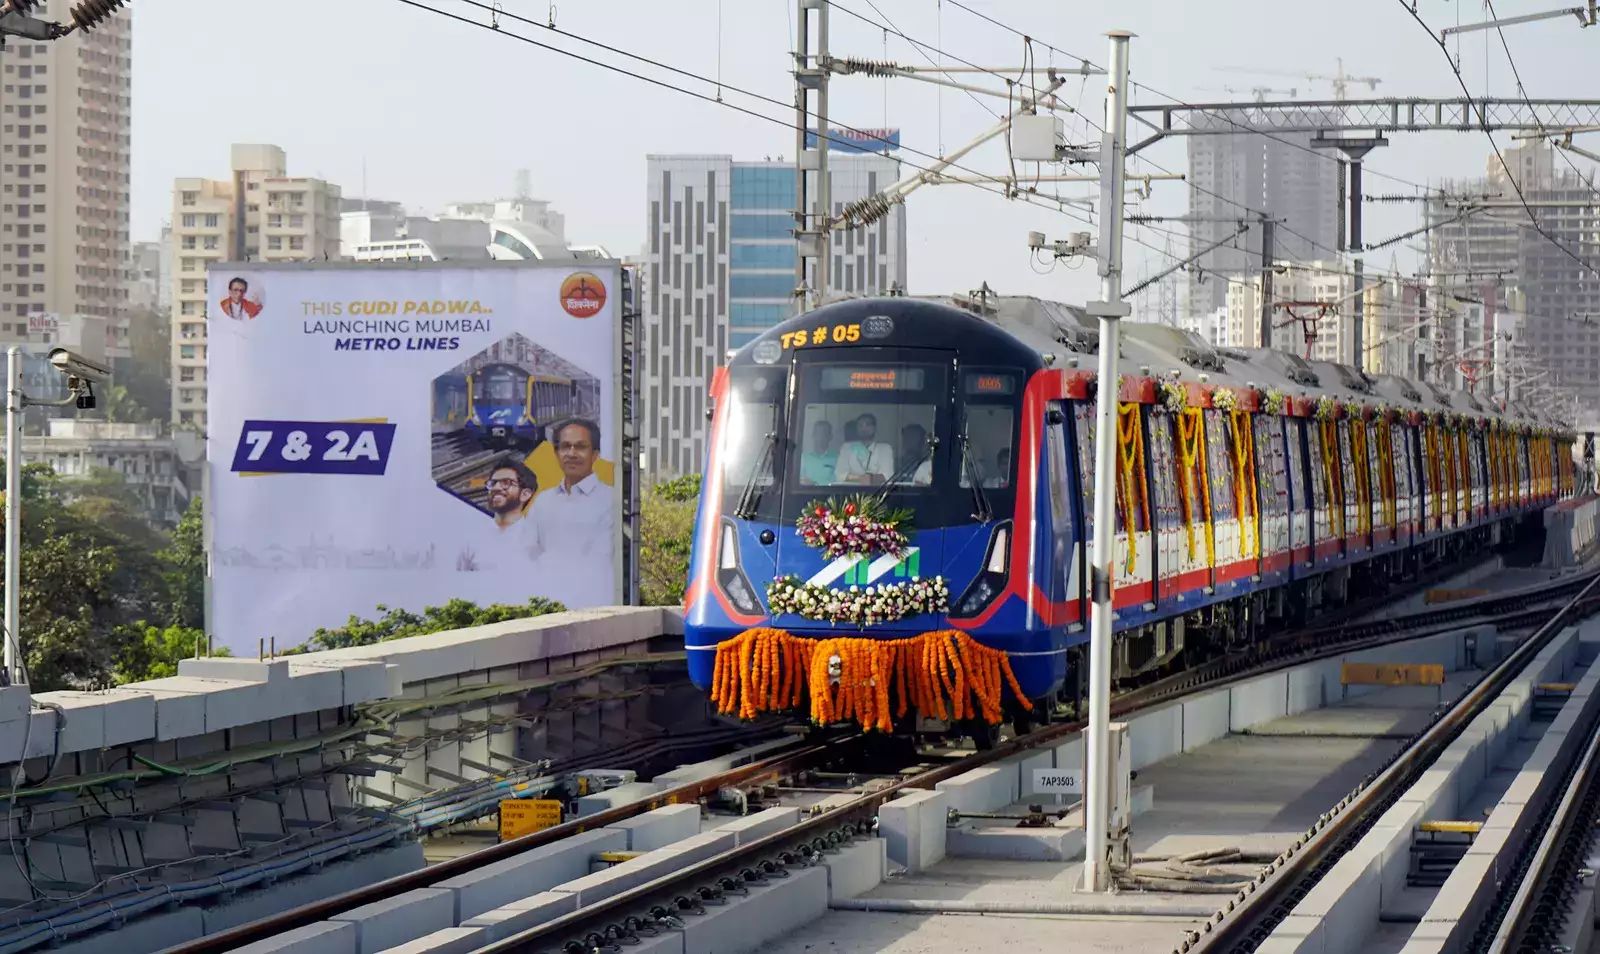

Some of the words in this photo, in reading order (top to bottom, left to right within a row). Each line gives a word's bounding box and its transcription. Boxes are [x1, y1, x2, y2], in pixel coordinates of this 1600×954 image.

[302, 302, 343, 315] THIS
[347, 301, 398, 315] GUDI
[402, 300, 493, 315] PADWA..
[303, 320, 409, 334] LAUNCHING
[415, 319, 490, 333] MUMBAI
[334, 338, 400, 351] METRO
[406, 337, 460, 350] LINES
[780, 329, 808, 350] TS
[812, 326, 828, 345] #
[832, 324, 861, 343] 05
[245, 430, 274, 461] 7
[281, 430, 313, 461] &
[322, 430, 381, 461] 2A
[1041, 776, 1075, 787] 7AP3503
